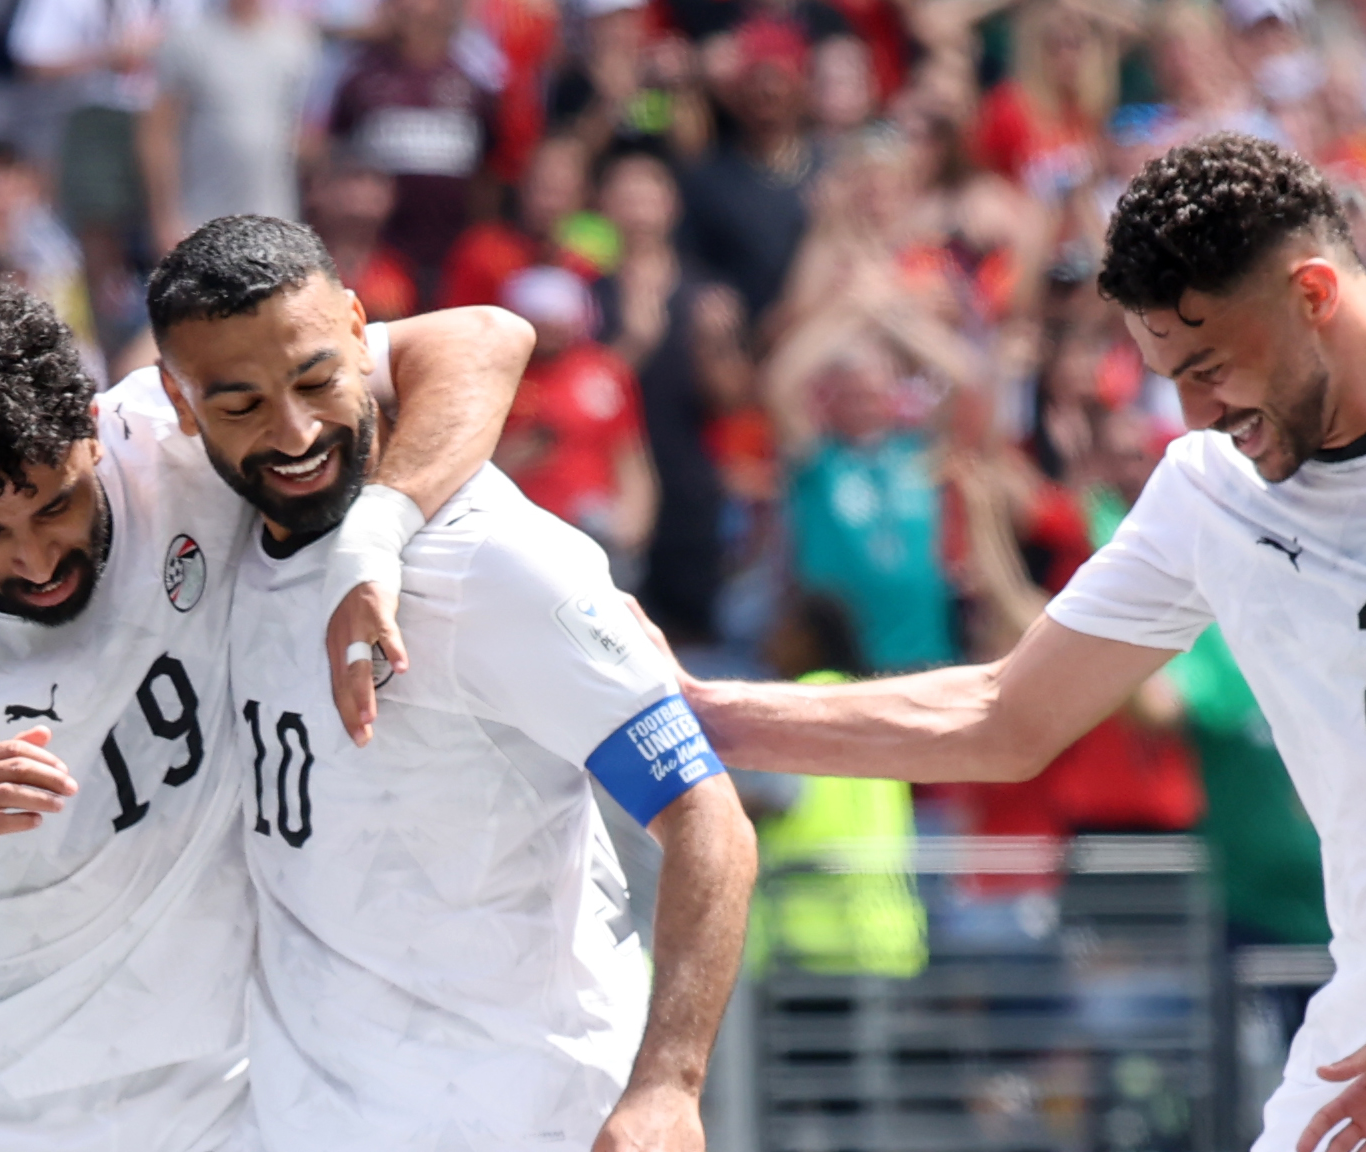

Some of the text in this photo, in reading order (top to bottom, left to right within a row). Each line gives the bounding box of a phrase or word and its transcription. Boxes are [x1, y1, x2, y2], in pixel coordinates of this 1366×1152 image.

[101, 651, 205, 834] 19
[243, 699, 315, 848] 10
[636, 714, 701, 762] UNITES
